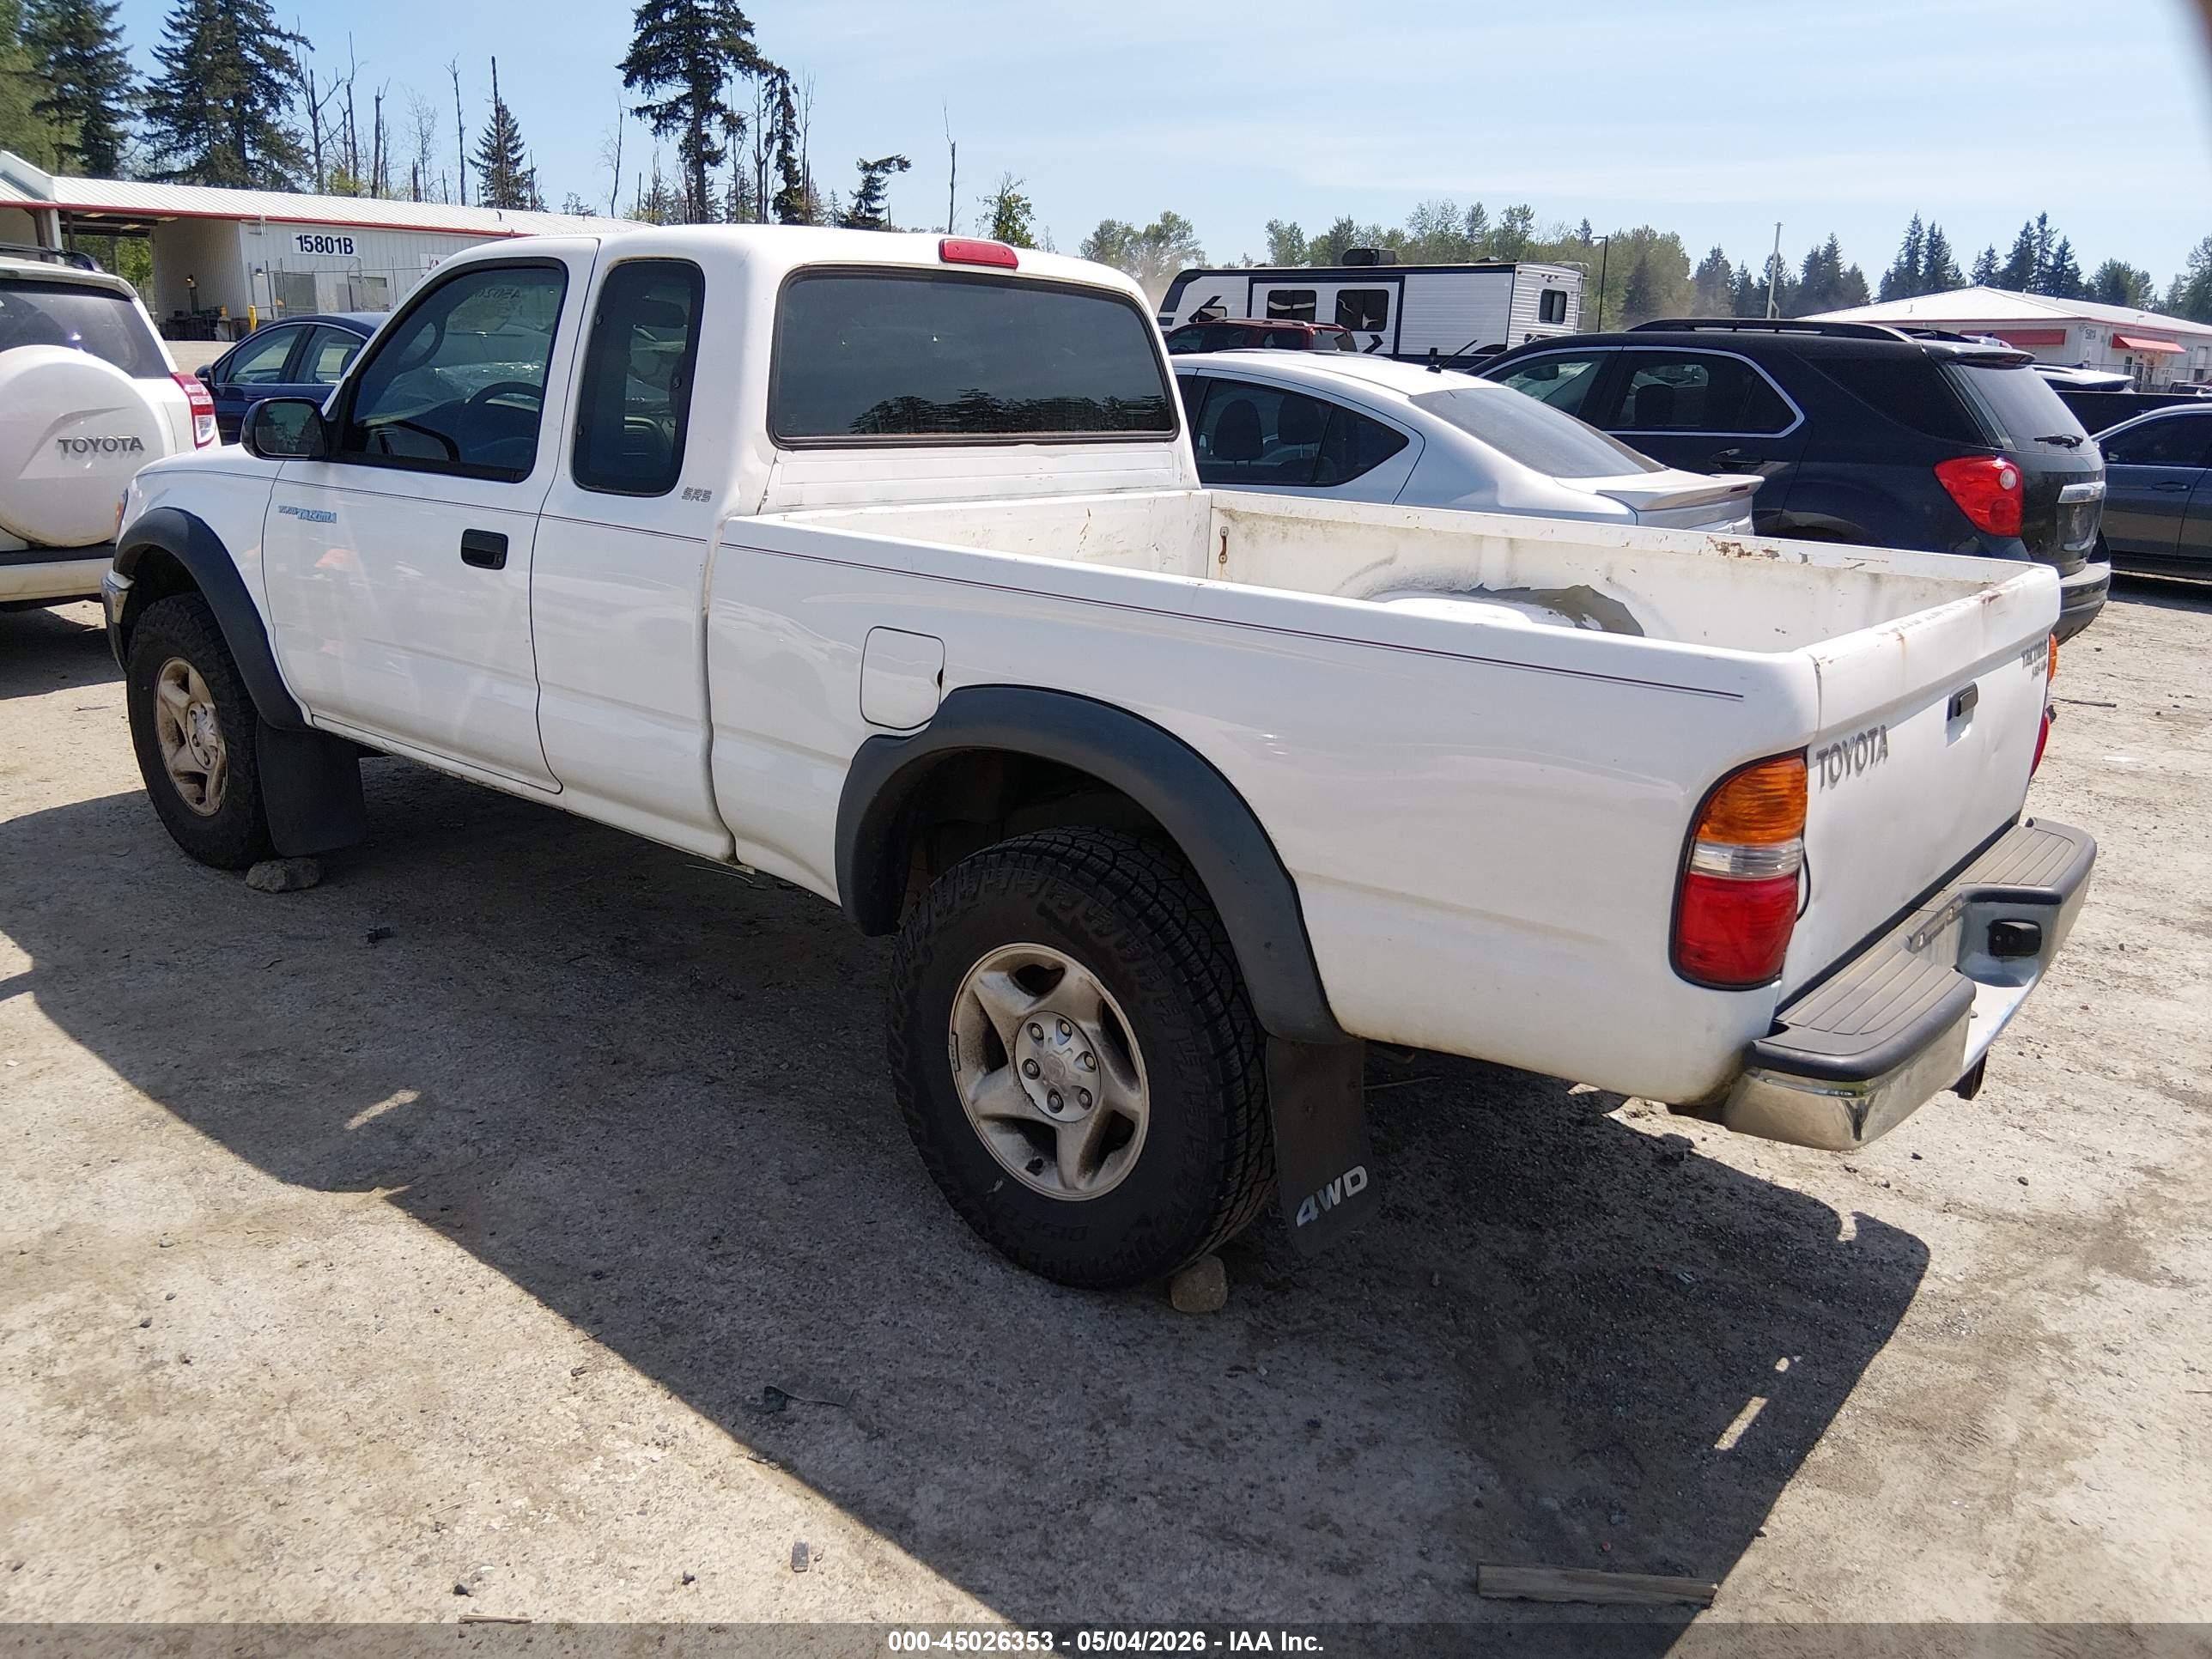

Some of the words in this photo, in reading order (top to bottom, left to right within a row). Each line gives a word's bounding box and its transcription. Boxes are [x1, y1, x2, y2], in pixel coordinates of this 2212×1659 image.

[295, 234, 355, 255] 15801B
[58, 435, 145, 454] TOYOTA
[1816, 725, 1889, 788] TOYOTA
[1296, 1165, 1368, 1227] 4WD
